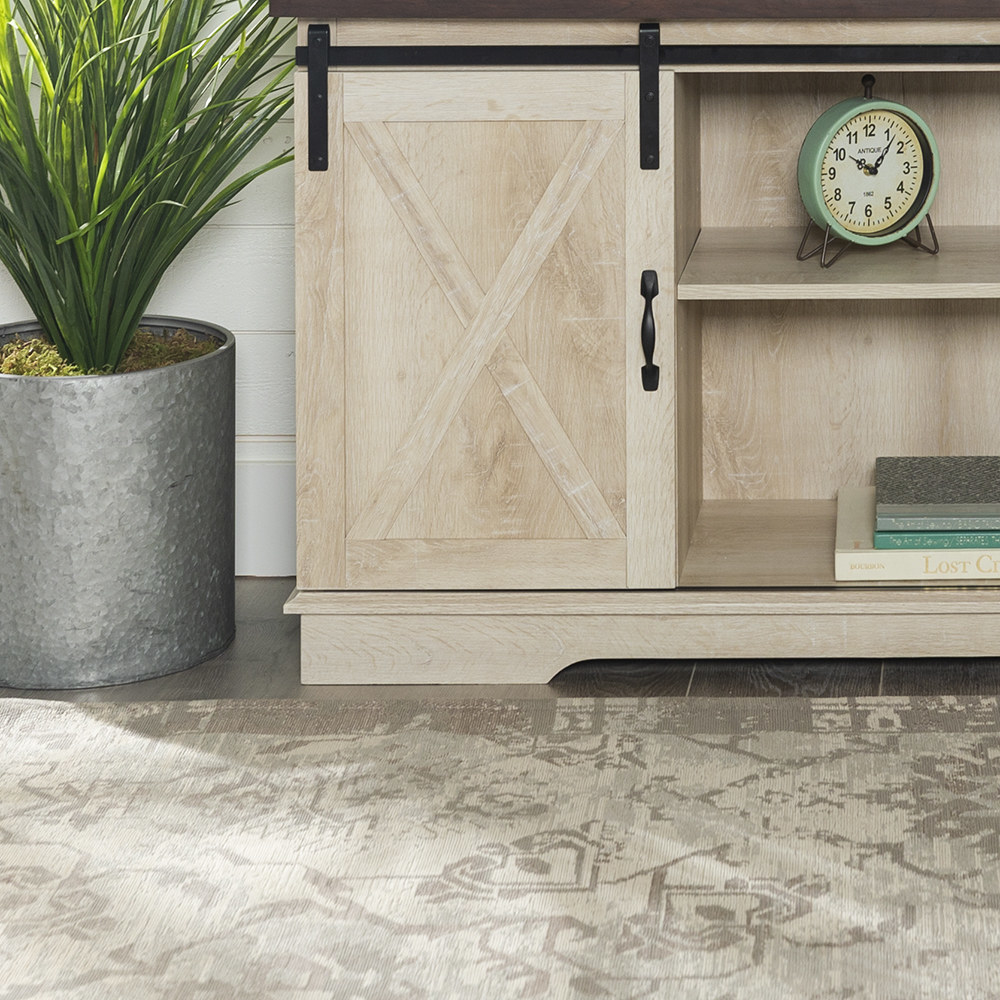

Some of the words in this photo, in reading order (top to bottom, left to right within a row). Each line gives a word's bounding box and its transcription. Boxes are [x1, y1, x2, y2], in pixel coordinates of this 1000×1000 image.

[862, 124, 876, 137] 12
[884, 128, 890, 141] 1
[846, 131, 858, 144] 11
[857, 146, 882, 154] ANTIQUE
[896, 141, 905, 154] 2
[833, 148, 846, 161] 10
[828, 167, 836, 180] 9
[903, 162, 911, 175] 3
[896, 181, 905, 194] 4
[834, 188, 842, 201] 8
[848, 201, 856, 214] 7
[884, 197, 892, 209] 5
[864, 204, 872, 217] 6
